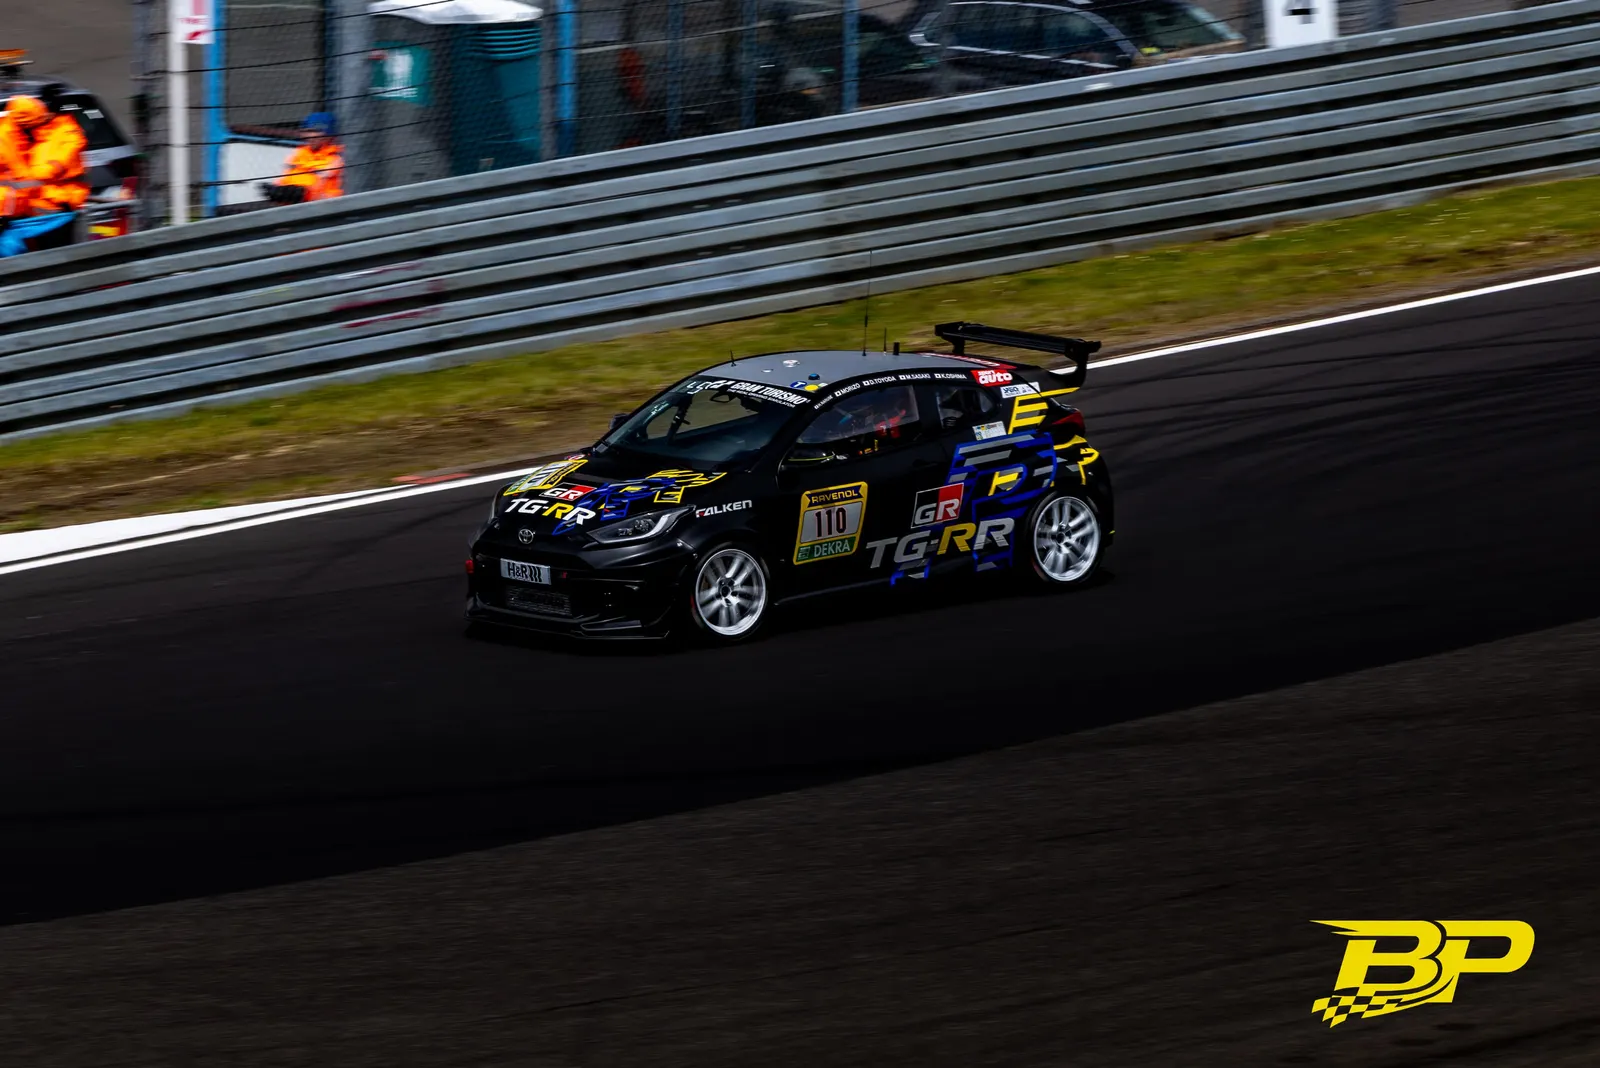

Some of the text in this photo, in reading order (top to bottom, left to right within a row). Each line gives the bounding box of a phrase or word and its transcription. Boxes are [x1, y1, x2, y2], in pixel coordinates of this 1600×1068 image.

[869, 376, 897, 385] D.TOYODA
[978, 372, 1013, 385] auto
[730, 382, 808, 405] GRAN TURISMO
[840, 383, 861, 394] MORIZO
[543, 488, 584, 501] GR
[811, 489, 859, 504] RAVENOL
[504, 498, 597, 526] TG-RR
[695, 499, 753, 518] FALKEN
[914, 498, 960, 525] GR
[815, 507, 847, 538] 110
[813, 540, 851, 558] DEKRA
[865, 517, 1015, 569] TG-RR
